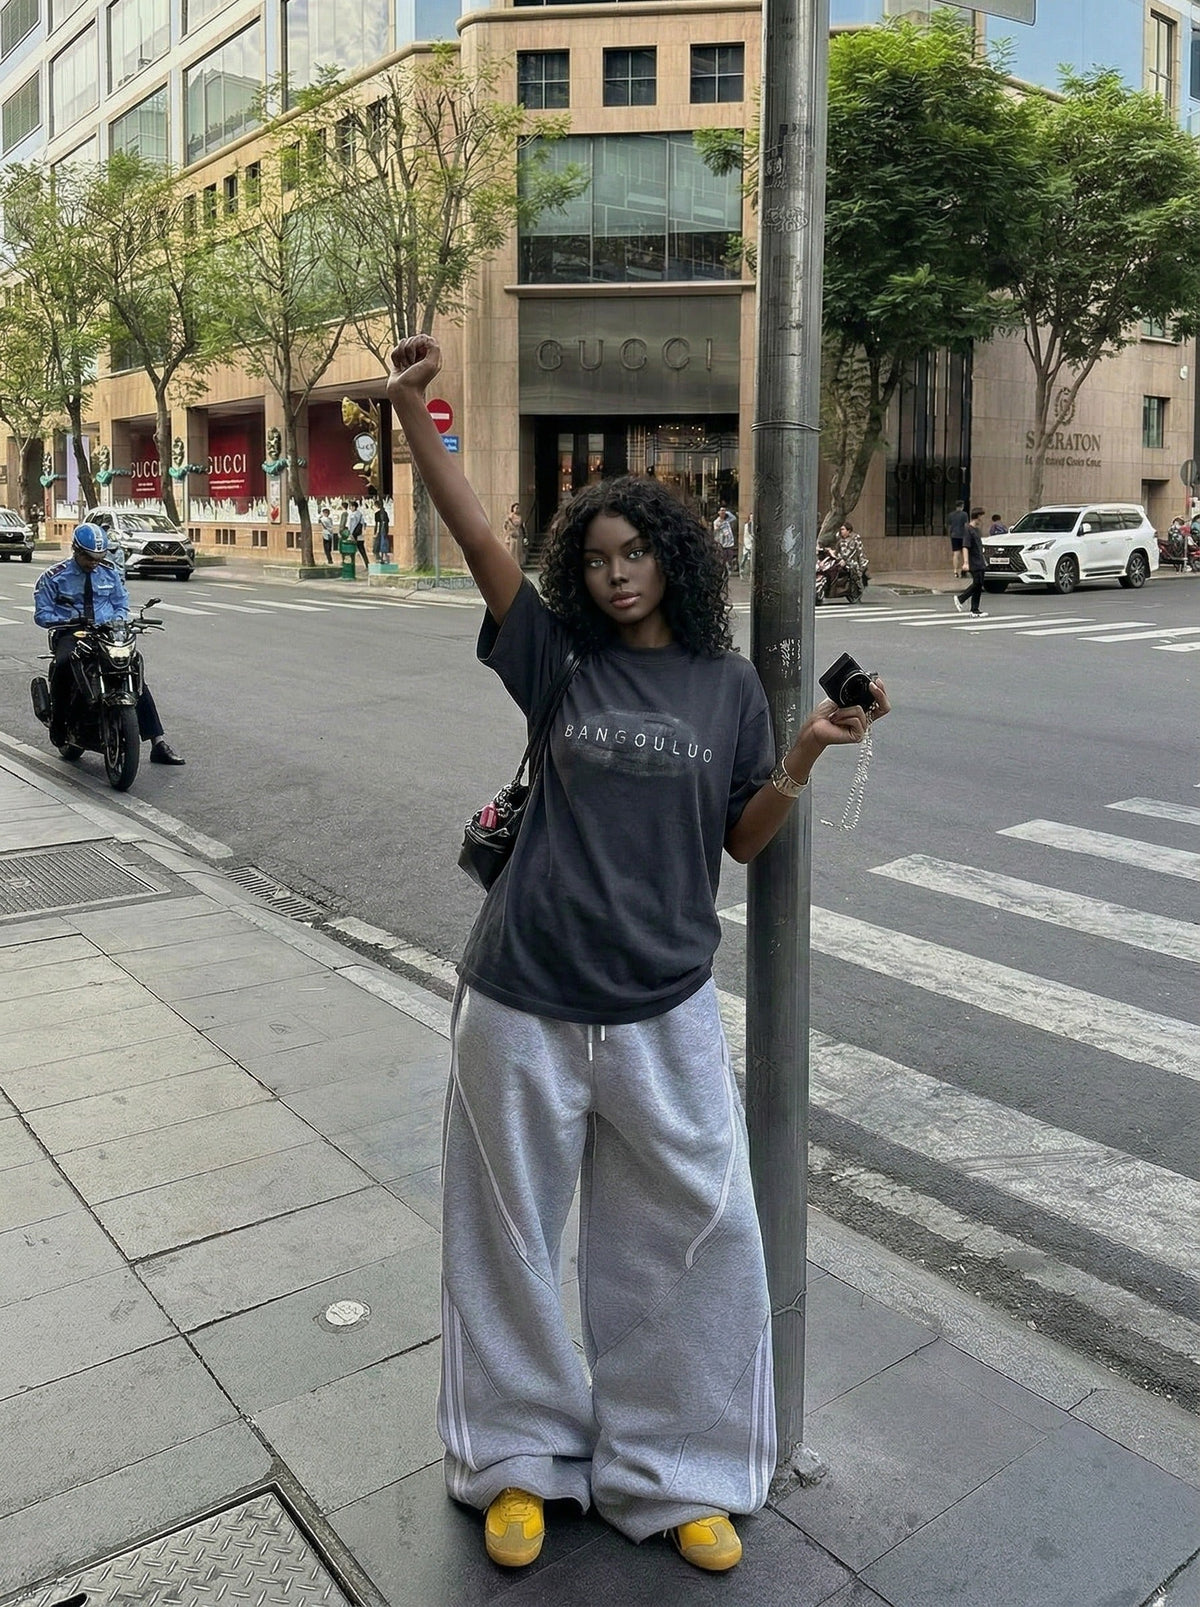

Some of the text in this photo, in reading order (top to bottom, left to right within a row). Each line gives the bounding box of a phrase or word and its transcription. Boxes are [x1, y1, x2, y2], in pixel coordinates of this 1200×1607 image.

[536, 337, 713, 371] GUCCI
[1025, 431, 1101, 452] SERATON
[564, 724, 712, 763] BANGOULUO
